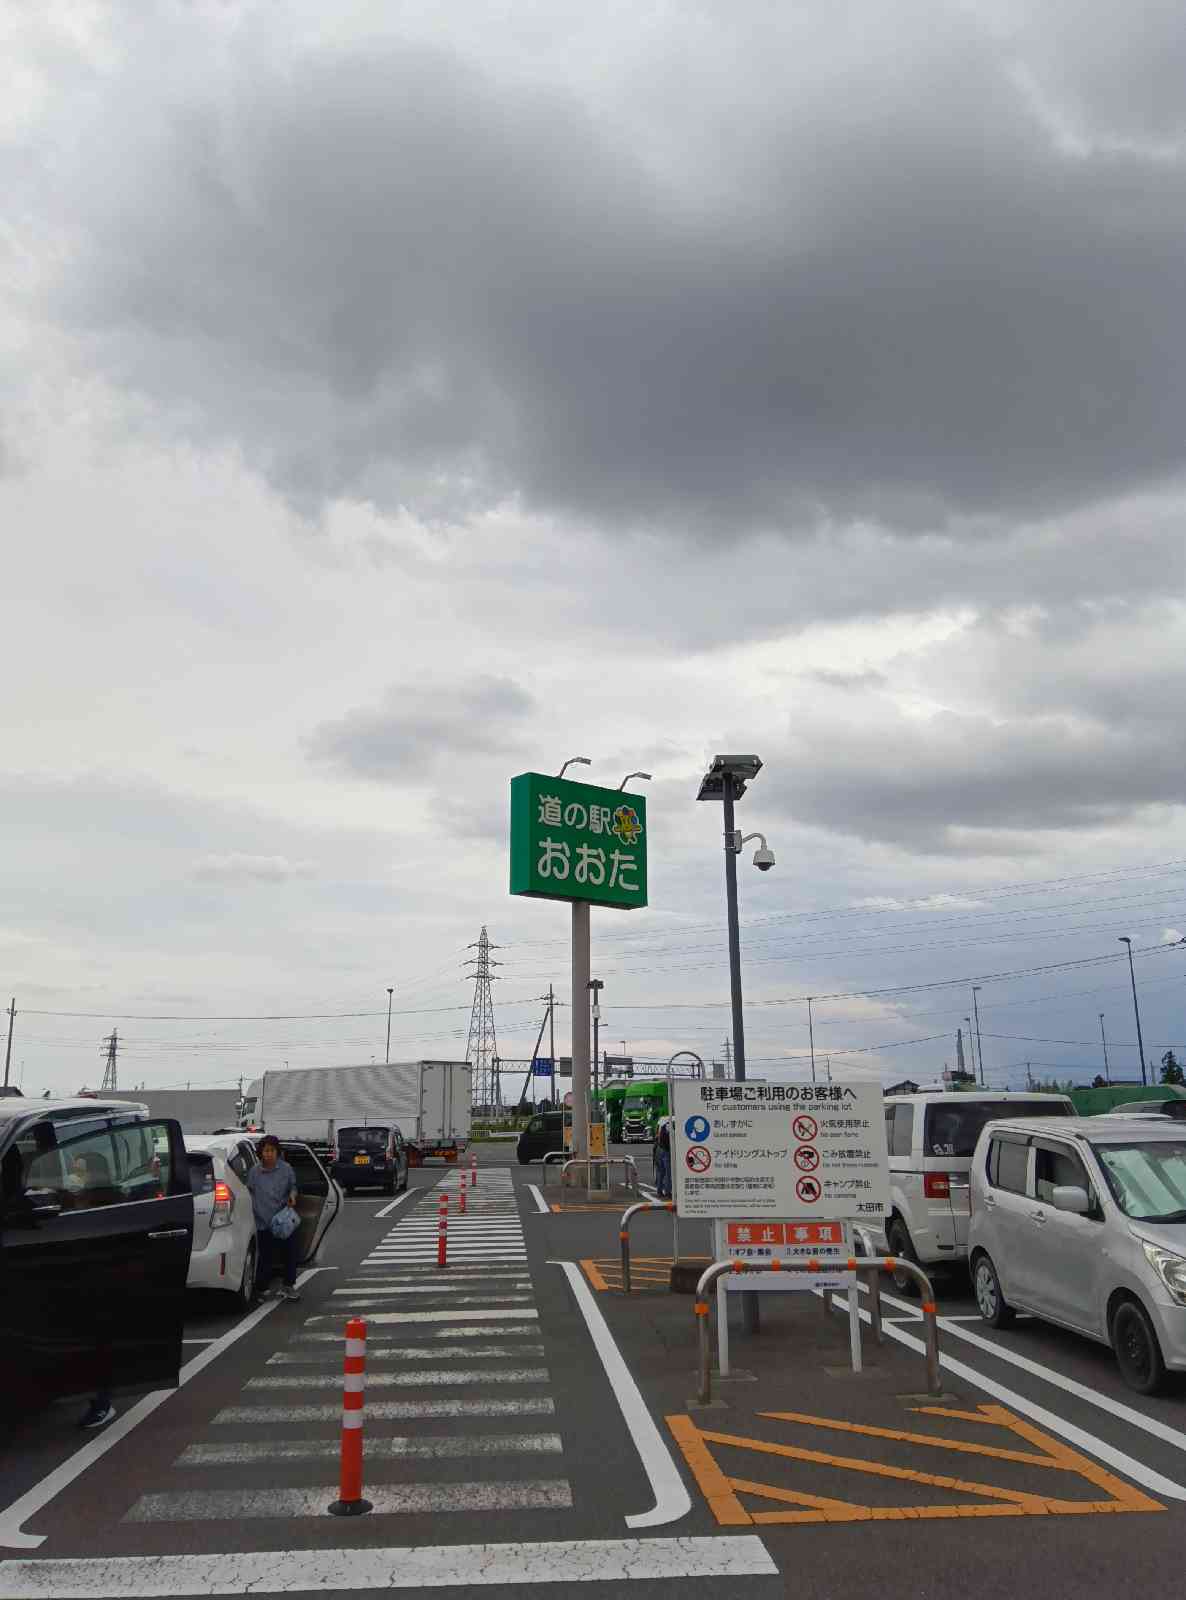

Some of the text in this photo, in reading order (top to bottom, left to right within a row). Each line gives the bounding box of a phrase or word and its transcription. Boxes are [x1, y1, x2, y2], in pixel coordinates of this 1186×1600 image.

[537, 793, 612, 836] 道の駅
[537, 836, 640, 891] おおた
[700, 1086, 857, 1101] 駐車場ご利用のお客様へ
[706, 1103, 852, 1112] For customers using the parking lot
[713, 1149, 788, 1159] アイドリングストップ
